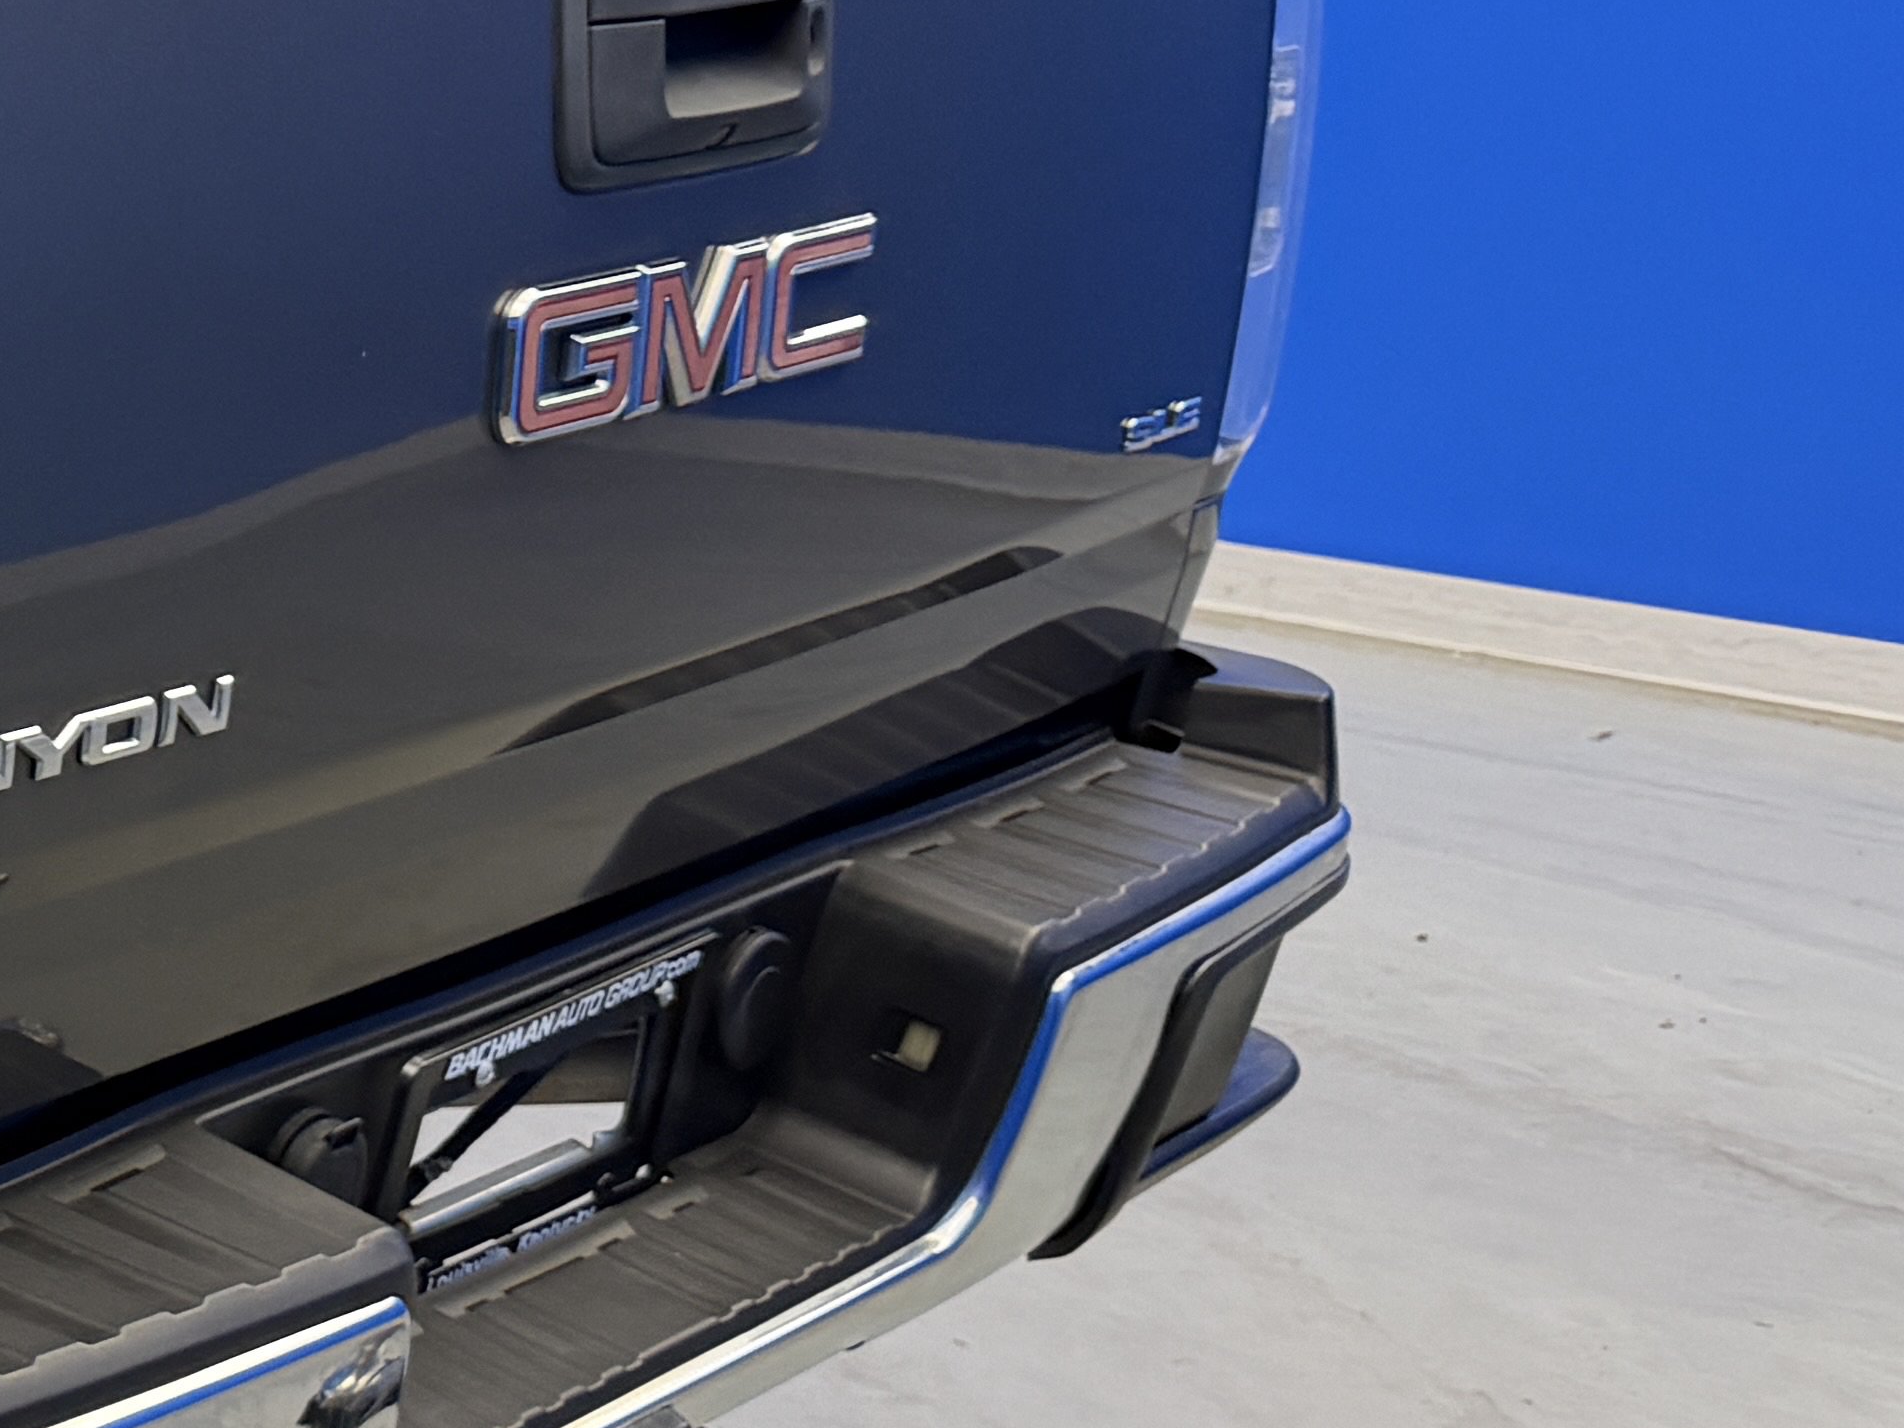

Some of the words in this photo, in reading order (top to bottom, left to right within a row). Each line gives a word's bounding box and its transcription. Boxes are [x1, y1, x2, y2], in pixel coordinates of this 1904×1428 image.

[495, 212, 878, 446] GMC
[444, 1011, 553, 1081] BACHMAN
[550, 990, 605, 1032] AUTO
